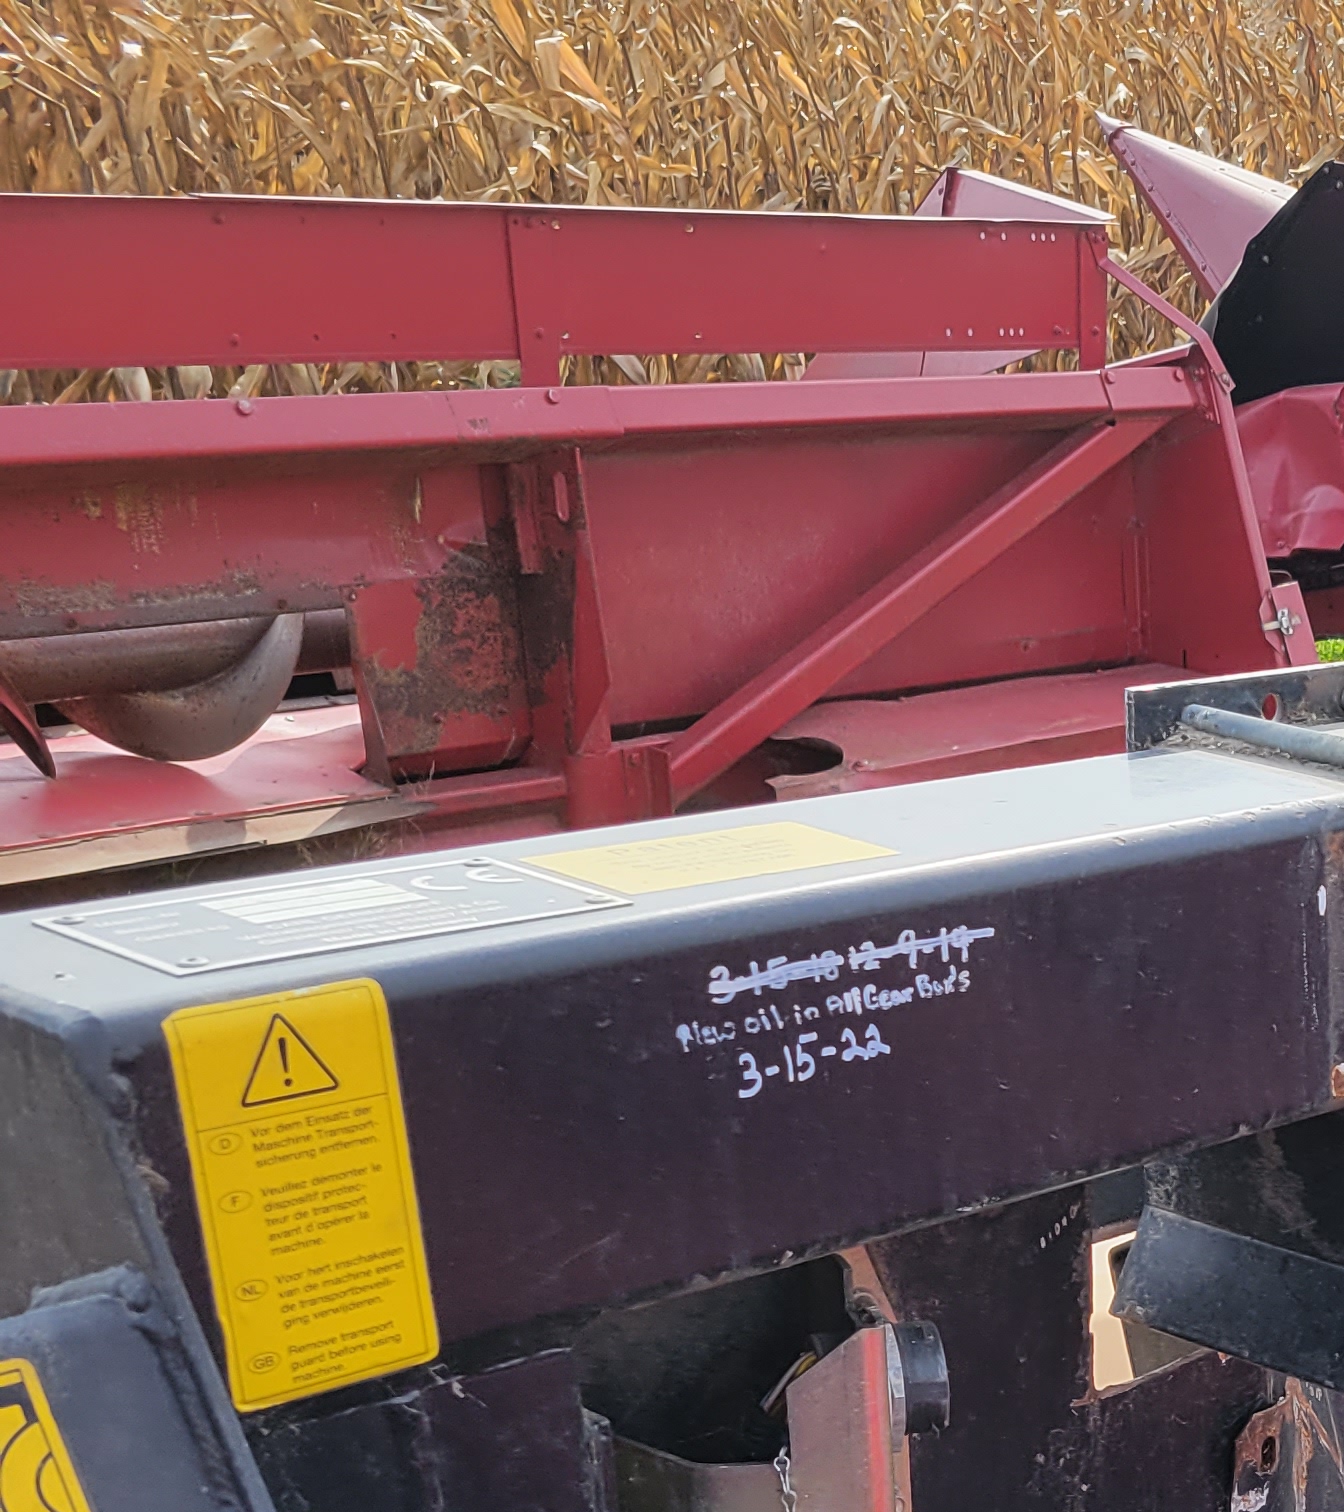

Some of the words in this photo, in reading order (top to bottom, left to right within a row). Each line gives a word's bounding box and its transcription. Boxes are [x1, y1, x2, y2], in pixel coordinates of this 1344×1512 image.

[744, 1003, 785, 1034] oil
[738, 1023, 891, 1099] 3-15-22
[250, 1127, 271, 1138] Vor
[275, 1120, 303, 1133] dem
[305, 1110, 351, 1127] Einsatz
[352, 1106, 372, 1117] der
[252, 1133, 313, 1152] Maschine
[255, 1148, 318, 1169] sicherung
[261, 1180, 308, 1197] Veuillez
[370, 1162, 383, 1173] le
[264, 1191, 320, 1213] dispositif
[294, 1210, 310, 1221] de
[311, 1195, 368, 1217] transport
[268, 1226, 302, 1242] avant
[274, 1271, 305, 1284] Voor
[334, 1247, 405, 1271] inschakelen
[241, 1285, 262, 1297] NL
[279, 1287, 300, 1299] van
[303, 1283, 320, 1293] de
[322, 1268, 374, 1287] machine
[375, 1259, 405, 1275] eerst
[281, 1302, 297, 1314] de
[283, 1314, 311, 1331] ging
[288, 1336, 338, 1354] Remove
[340, 1320, 394, 1342] transport
[254, 1355, 275, 1369] GB
[291, 1352, 326, 1372] guard
[328, 1343, 368, 1360] before
[369, 1333, 403, 1349] using
